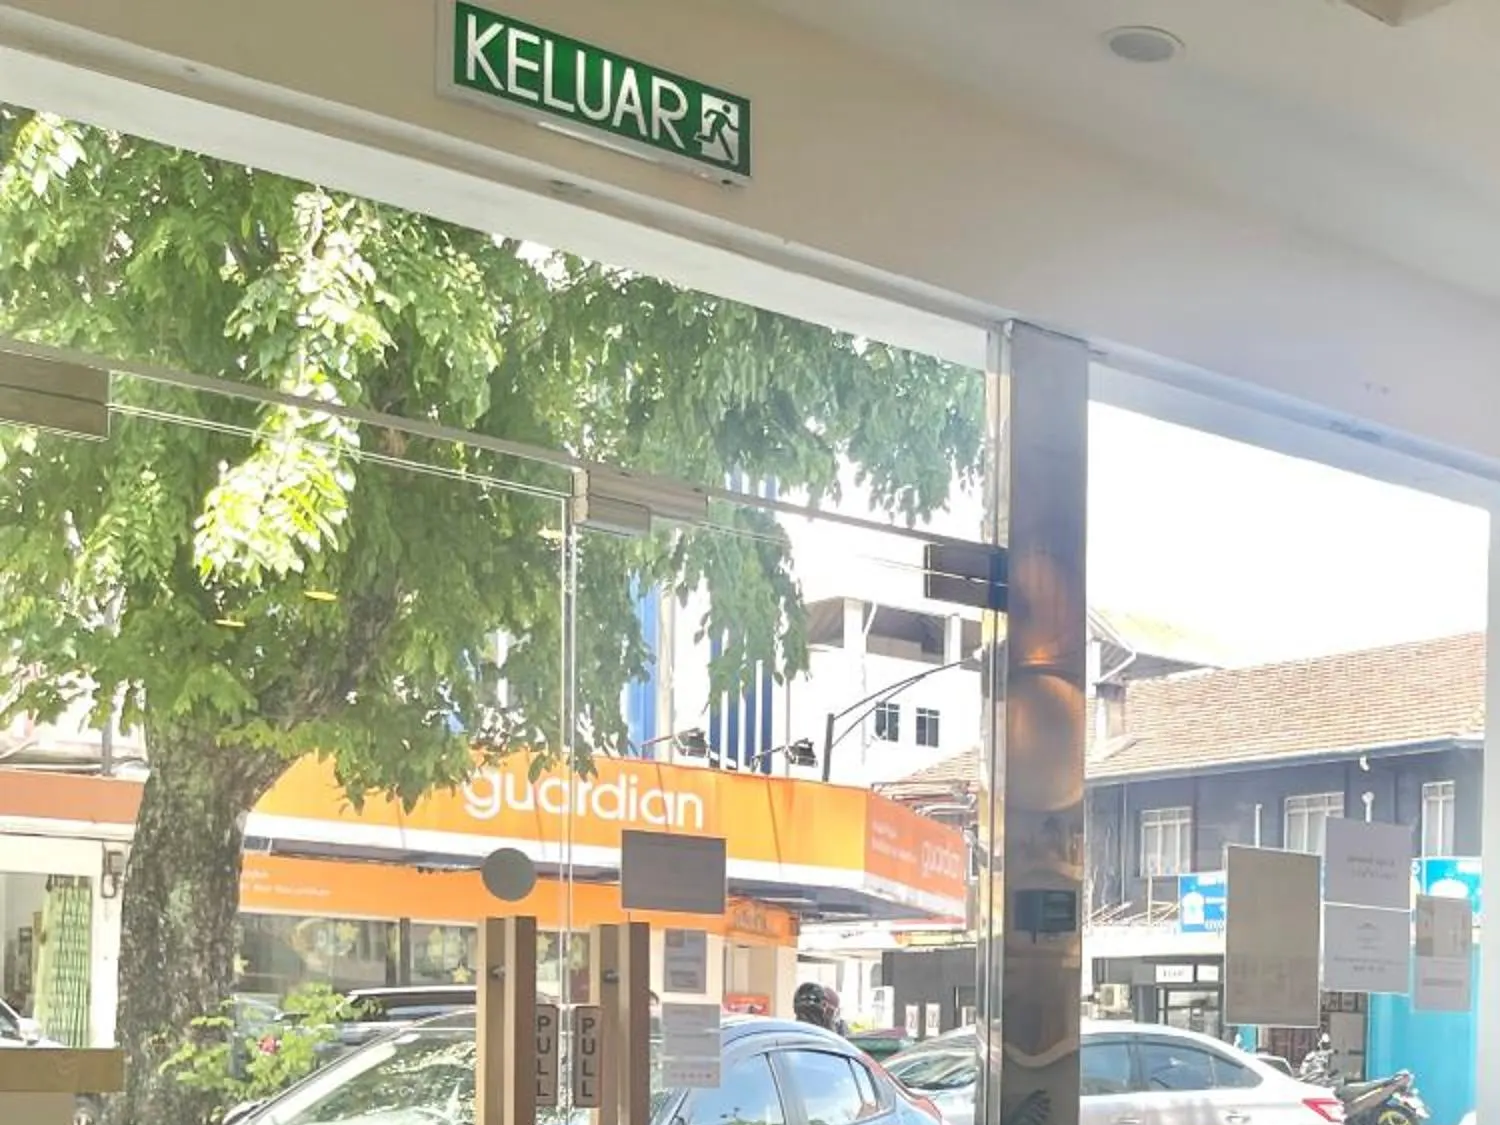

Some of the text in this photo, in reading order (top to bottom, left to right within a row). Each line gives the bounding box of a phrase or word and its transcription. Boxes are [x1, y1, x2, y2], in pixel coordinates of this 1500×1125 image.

[466, 13, 689, 150] KELUAR
[462, 769, 704, 830] guardian
[536, 1015, 551, 1097] PULL
[581, 1017, 595, 1098] PULL
